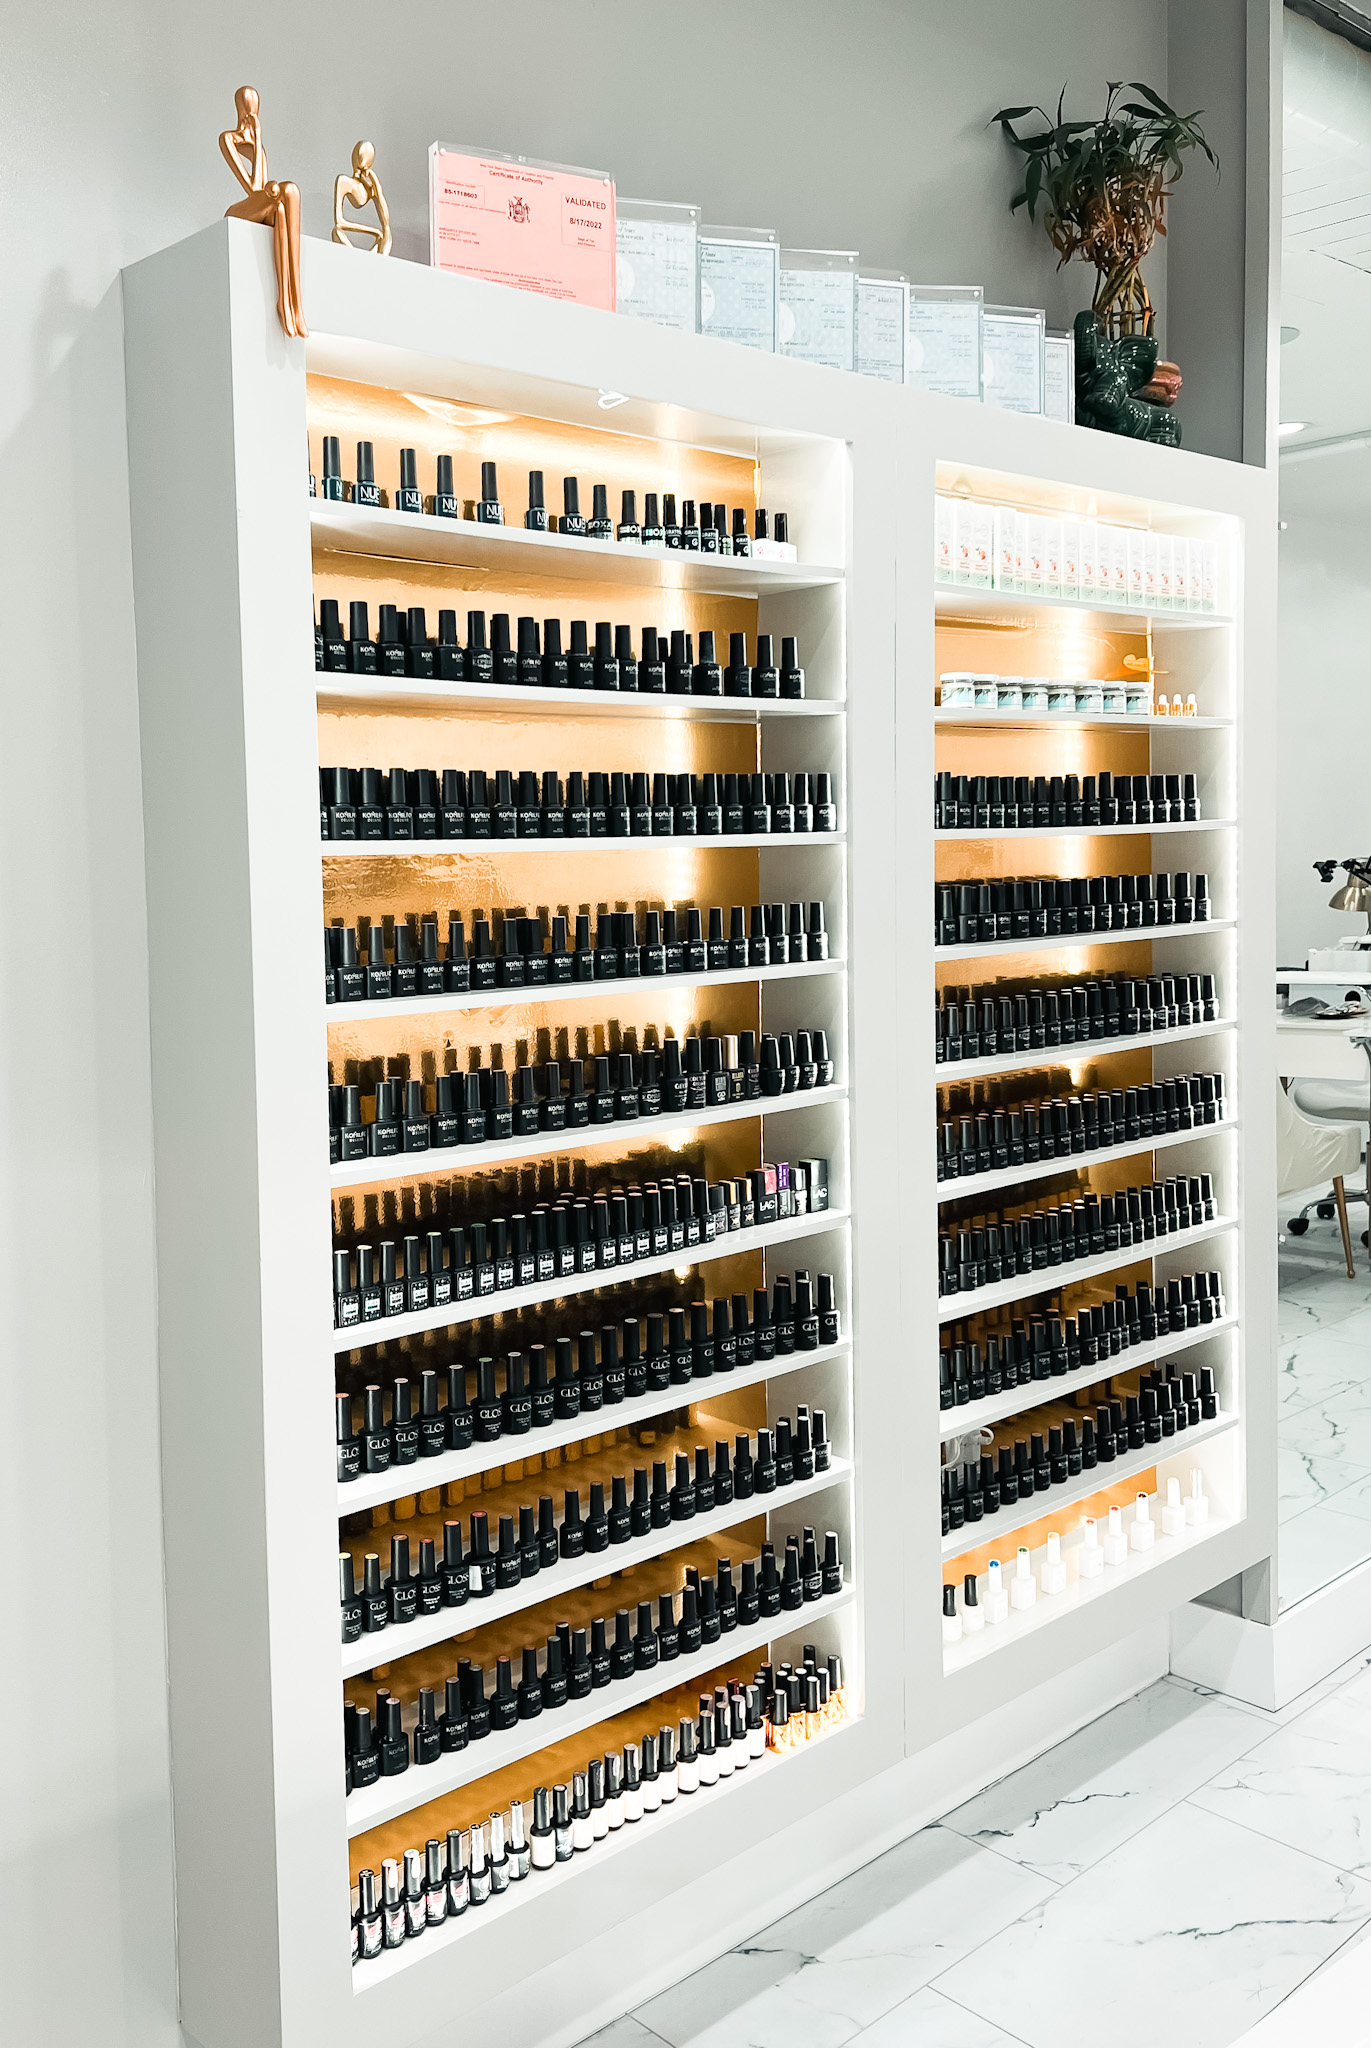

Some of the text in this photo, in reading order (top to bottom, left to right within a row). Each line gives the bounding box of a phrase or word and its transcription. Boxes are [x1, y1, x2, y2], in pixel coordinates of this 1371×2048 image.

[489, 170, 514, 180] Certificate
[521, 176, 544, 186] Authority
[564, 196, 607, 210] VALIDATED
[569, 217, 602, 230] 8/17/2022
